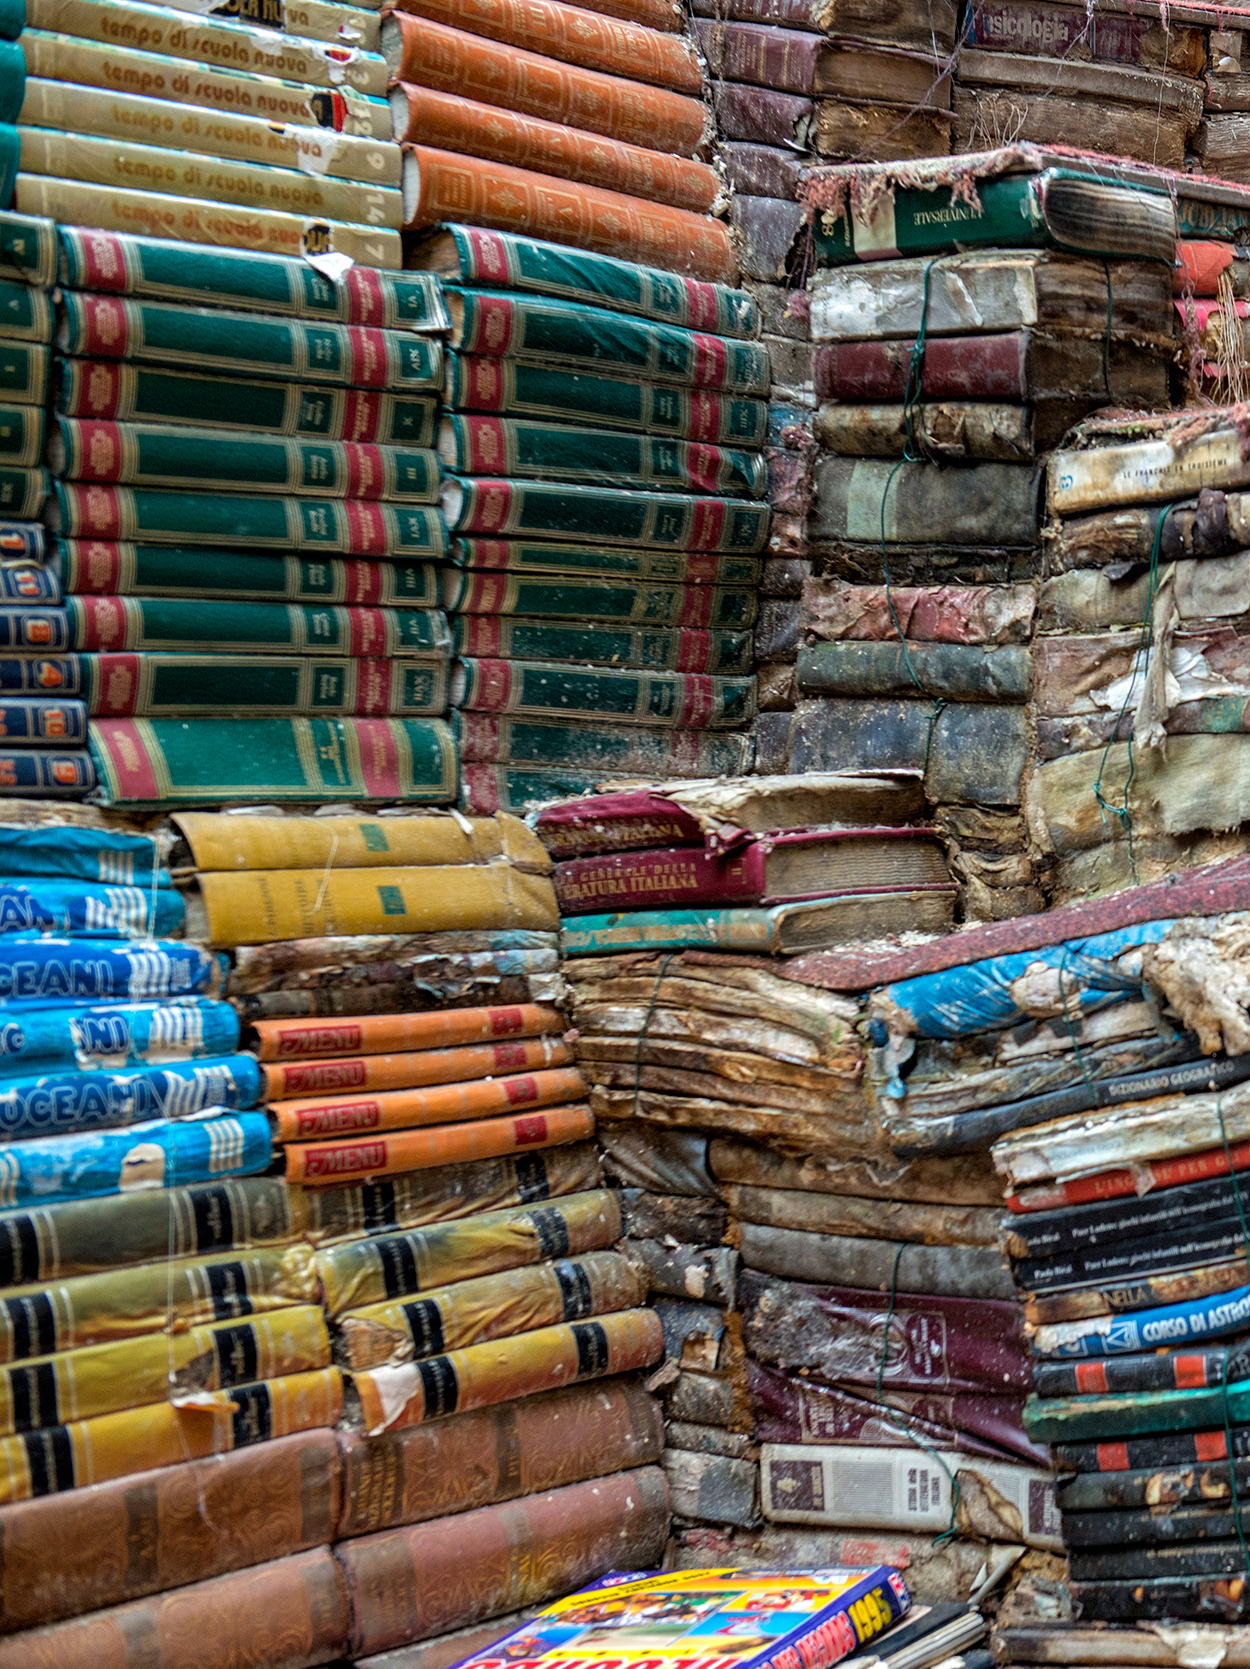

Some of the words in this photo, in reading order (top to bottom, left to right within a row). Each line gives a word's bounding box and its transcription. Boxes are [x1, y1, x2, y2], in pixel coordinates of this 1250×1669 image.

[983, 11, 1069, 41] psicologia
[101, 16, 163, 46] tempo
[169, 32, 189, 49] di
[192, 39, 249, 63] scuola
[254, 49, 307, 74] nuova
[102, 61, 165, 91] tempo
[172, 74, 190, 94] di
[195, 85, 251, 106] scuola
[257, 93, 310, 118] nuova
[111, 104, 174, 132] tempo
[181, 115, 199, 134] di
[204, 121, 262, 148] scuola
[267, 133, 323, 158] nuova
[113, 156, 176, 186] tempo
[183, 165, 201, 185] di
[206, 173, 265, 197] scuola
[270, 184, 323, 206] nuova
[112, 200, 175, 228] tempo
[182, 211, 200, 229] di
[206, 216, 263, 241] scuola
[268, 230, 303, 246] nuo
[1123, 469, 1132, 479] LE
[1174, 462, 1184, 473] EN
[45, 708, 65, 736] 10
[630, 873, 699, 893] ITALIANA
[281, 1027, 361, 1053] MENU
[286, 1063, 366, 1092] MENU
[1108, 1076, 1169, 1097] DIZIONARIO
[1170, 1061, 1235, 1086] GEOGRAFICO
[0, 1078, 150, 1130] OCEANI
[300, 1103, 380, 1134] MENU
[307, 1142, 386, 1178] MENU
[1177, 1156, 1207, 1176] PER
[1140, 1210, 1168, 1224] infantili
[1151, 1244, 1179, 1258] infantili
[1034, 1268, 1053, 1280] Paola
[1053, 1264, 1072, 1276] Biral
[1103, 1286, 1147, 1311] NELLA
[1142, 1317, 1187, 1343] CORSO
[1190, 1313, 1206, 1333] DI
[848, 1590, 893, 1645] 1995
